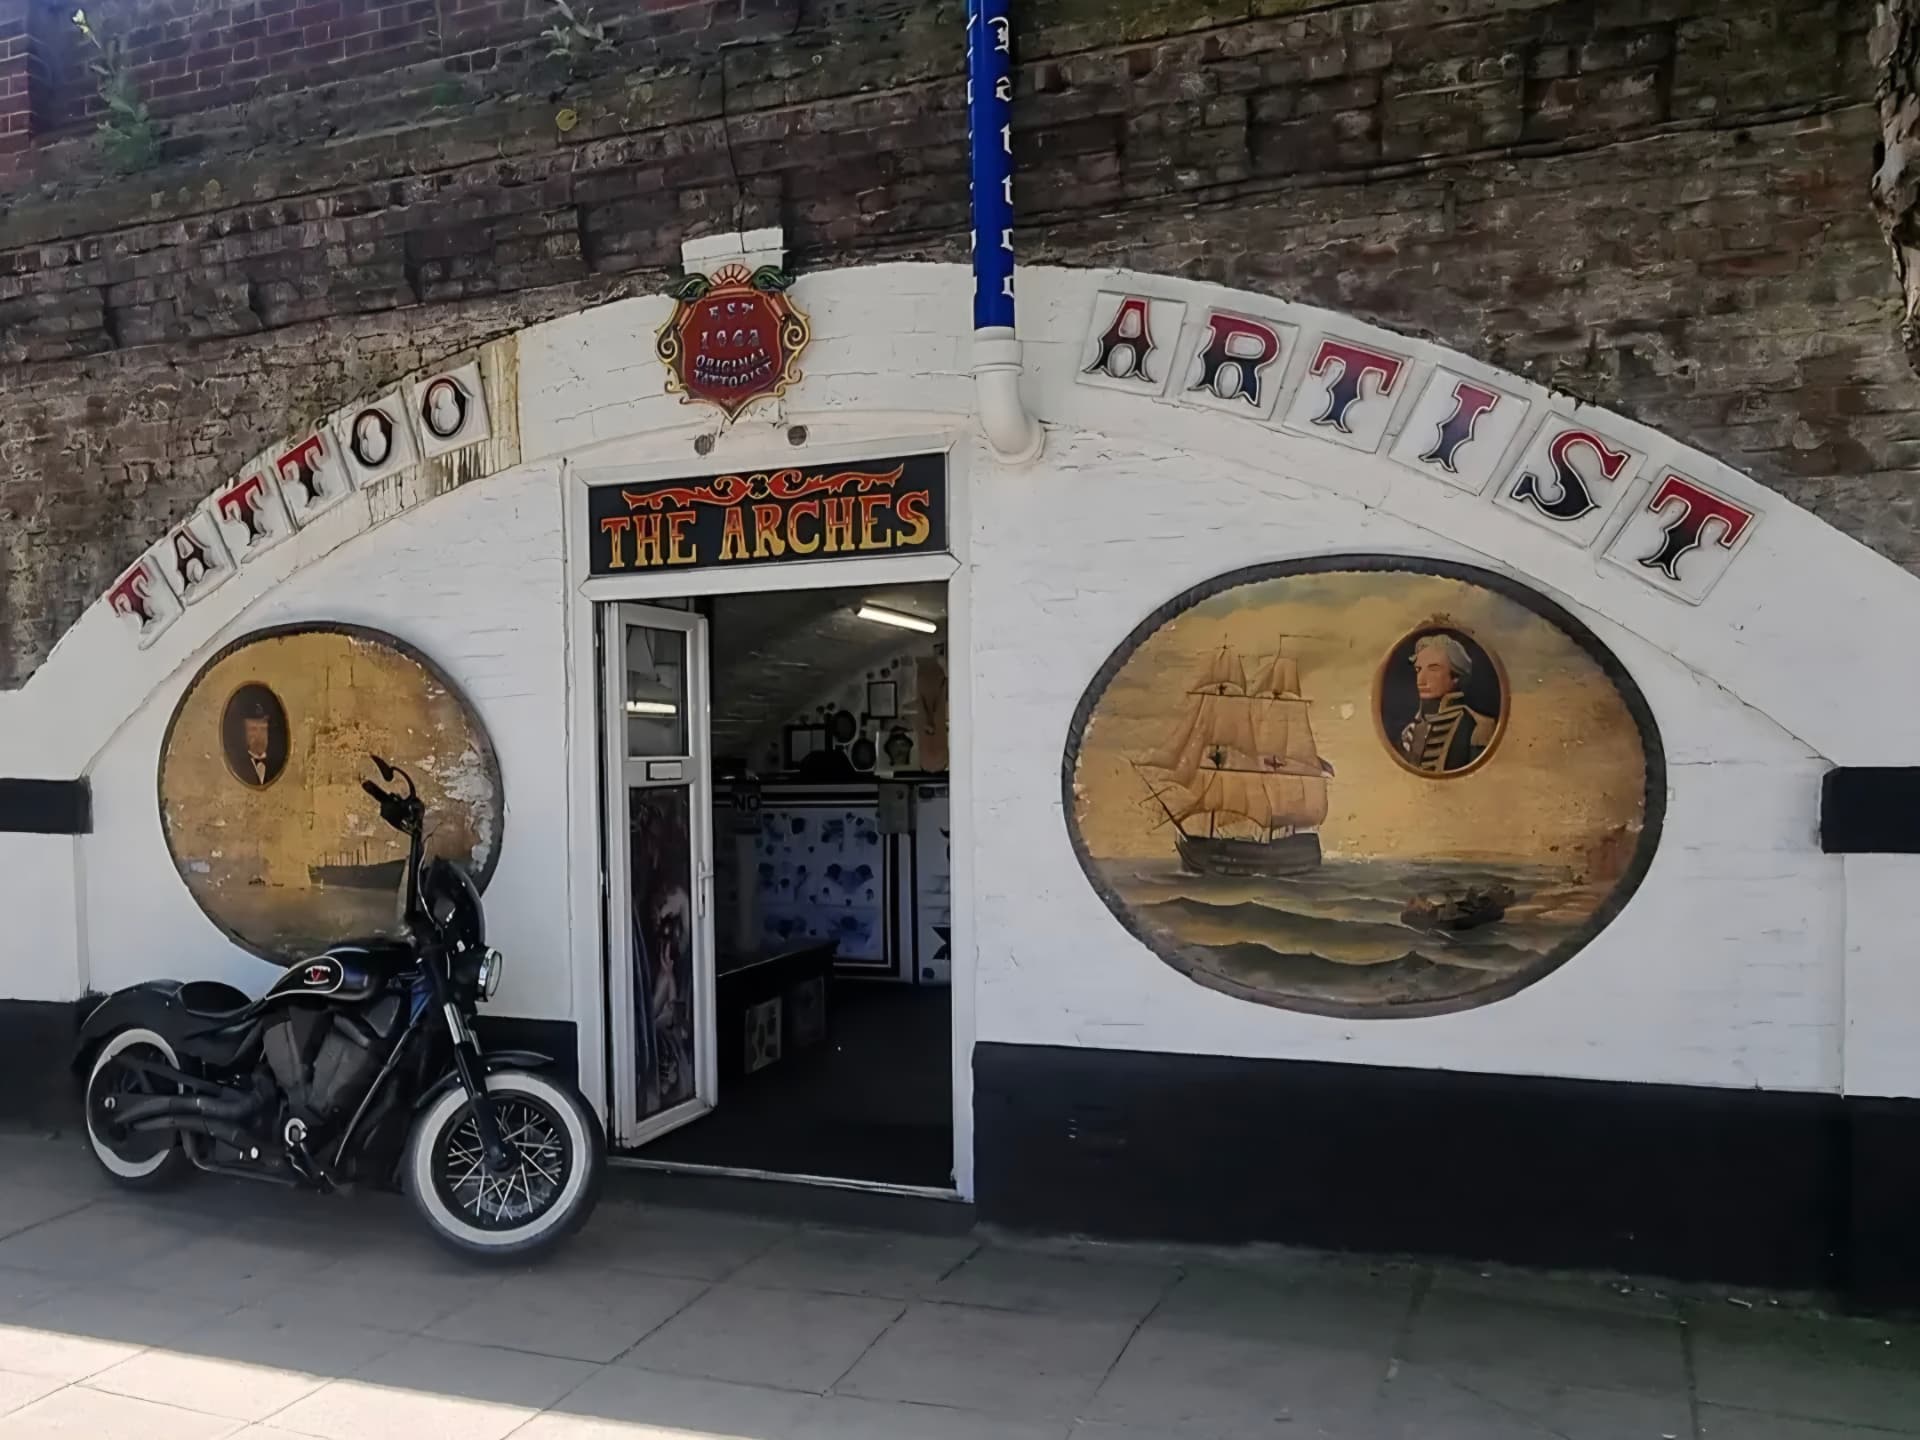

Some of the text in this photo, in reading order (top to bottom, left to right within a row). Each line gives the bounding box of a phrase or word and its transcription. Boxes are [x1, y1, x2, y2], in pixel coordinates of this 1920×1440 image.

[693, 361, 772, 388] TATTOOIST
[696, 348, 770, 373] ORIGINAL
[1080, 297, 1754, 581] ARTIST
[107, 374, 474, 628] TATTOO
[601, 490, 930, 568] THE ARCHES
